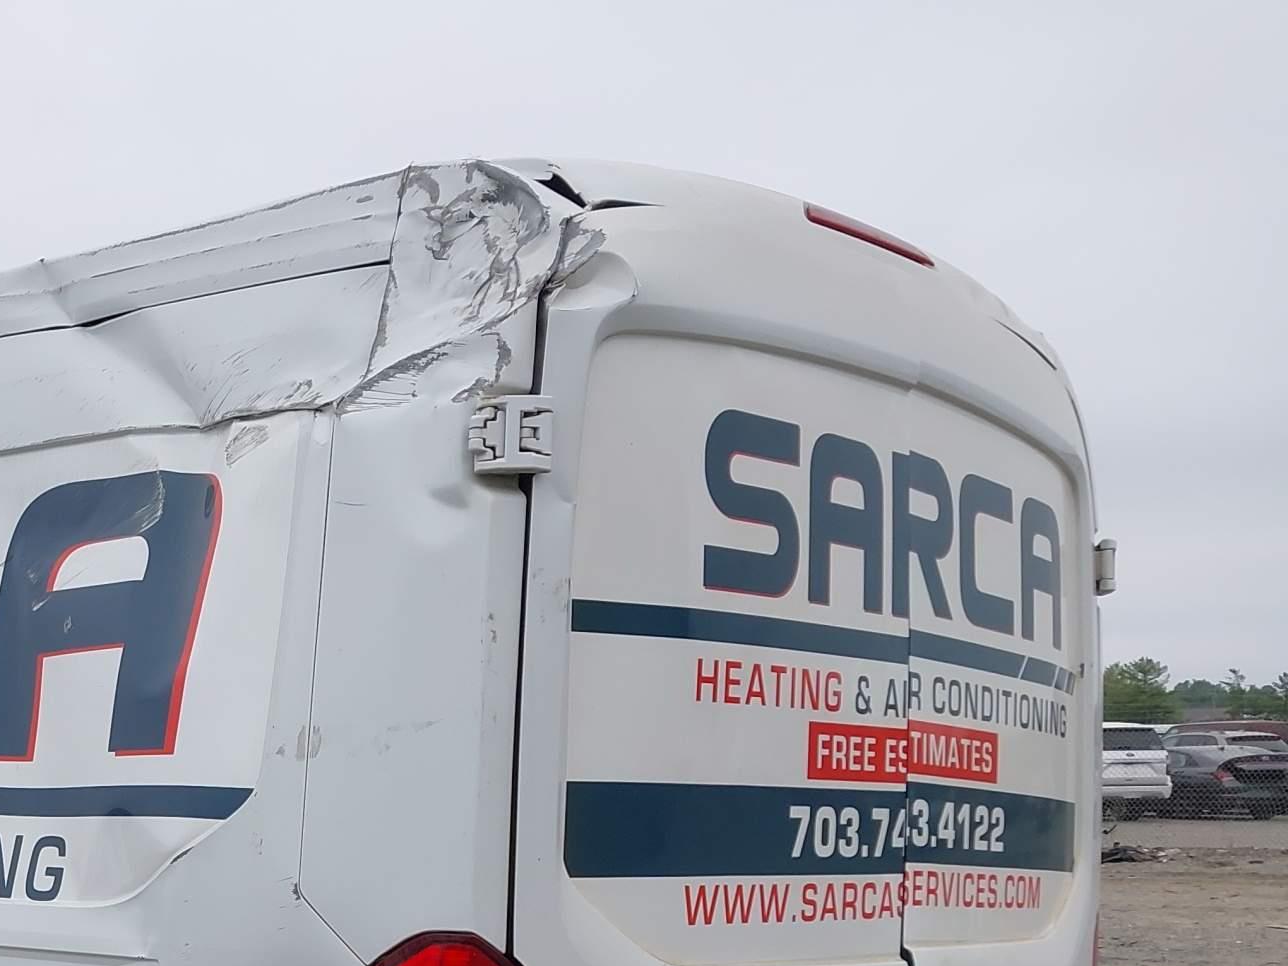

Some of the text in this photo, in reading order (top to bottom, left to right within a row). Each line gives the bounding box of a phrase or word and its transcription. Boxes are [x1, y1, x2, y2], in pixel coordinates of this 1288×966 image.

[703, 409, 1062, 651] SARCA
[696, 658, 1068, 739] HEATING & AIR CONDITIONING
[816, 730, 993, 774] FREE ESTIMATES
[789, 798, 1005, 859] 703.743.4122
[684, 870, 1042, 927] WWW.SARCASERVICES.COM
